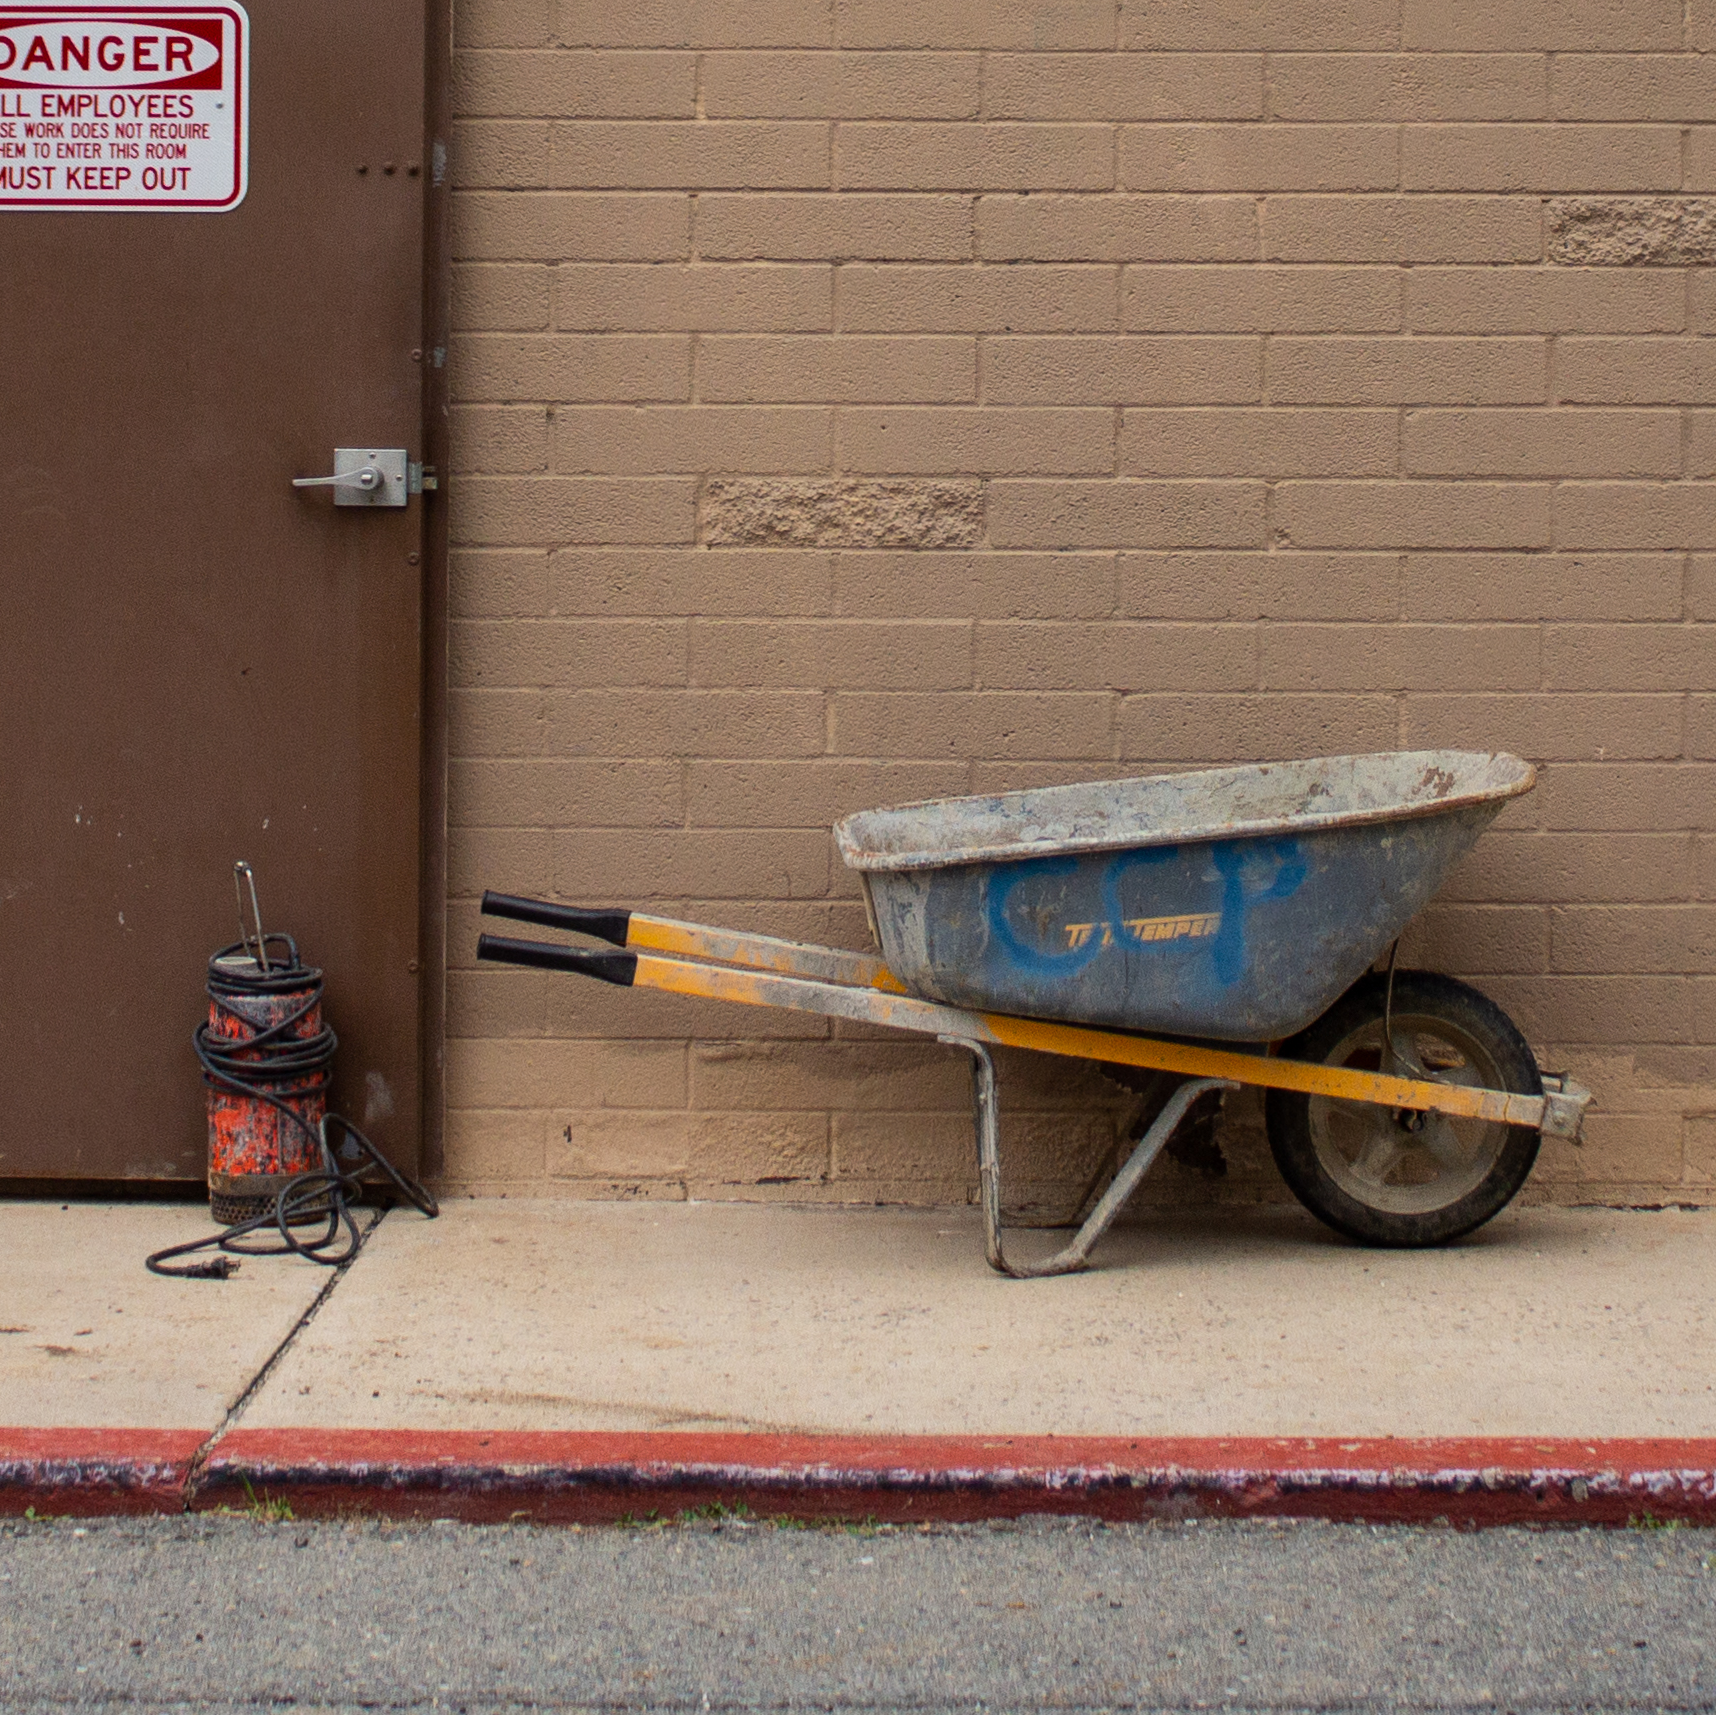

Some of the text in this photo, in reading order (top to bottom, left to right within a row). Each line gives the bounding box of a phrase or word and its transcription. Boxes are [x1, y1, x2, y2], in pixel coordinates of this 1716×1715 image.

[40, 94, 194, 118] EMPLOYEES
[24, 122, 65, 139] WORK
[71, 122, 109, 139] DOES
[114, 122, 146, 139] NOT
[149, 122, 211, 140] REQUIRE
[33, 142, 51, 159] TO
[56, 142, 102, 159] ENTER
[109, 142, 140, 159] THIS
[146, 142, 187, 160] ROOM
[65, 166, 132, 190] KEEP
[141, 166, 192, 191] OUT
